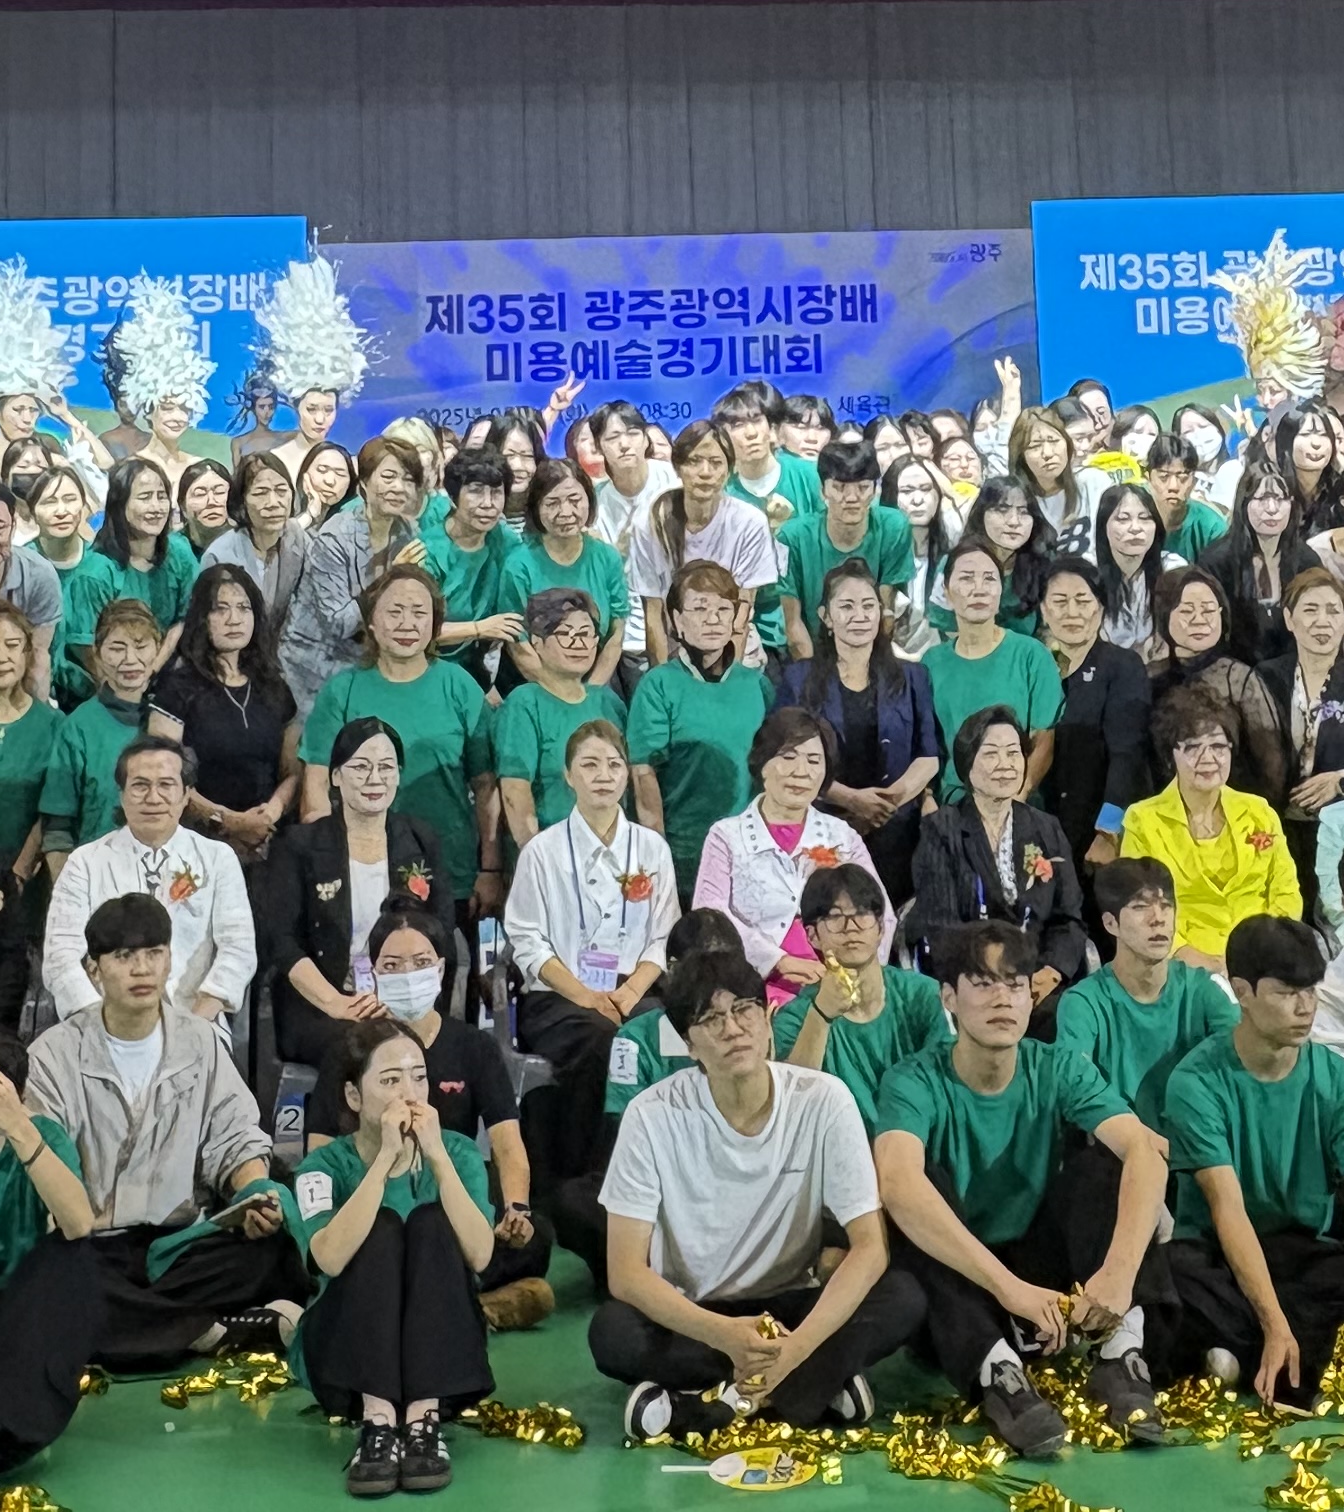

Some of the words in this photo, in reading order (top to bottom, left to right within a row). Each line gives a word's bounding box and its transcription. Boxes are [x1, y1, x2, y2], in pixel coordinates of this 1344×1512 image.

[1079, 251, 1207, 291] 제35회
[425, 292, 567, 335] 제35회
[584, 283, 878, 331] 광주광역시장배
[486, 334, 822, 382] 미용예술경기대회
[283, 1108, 300, 1132] 2
